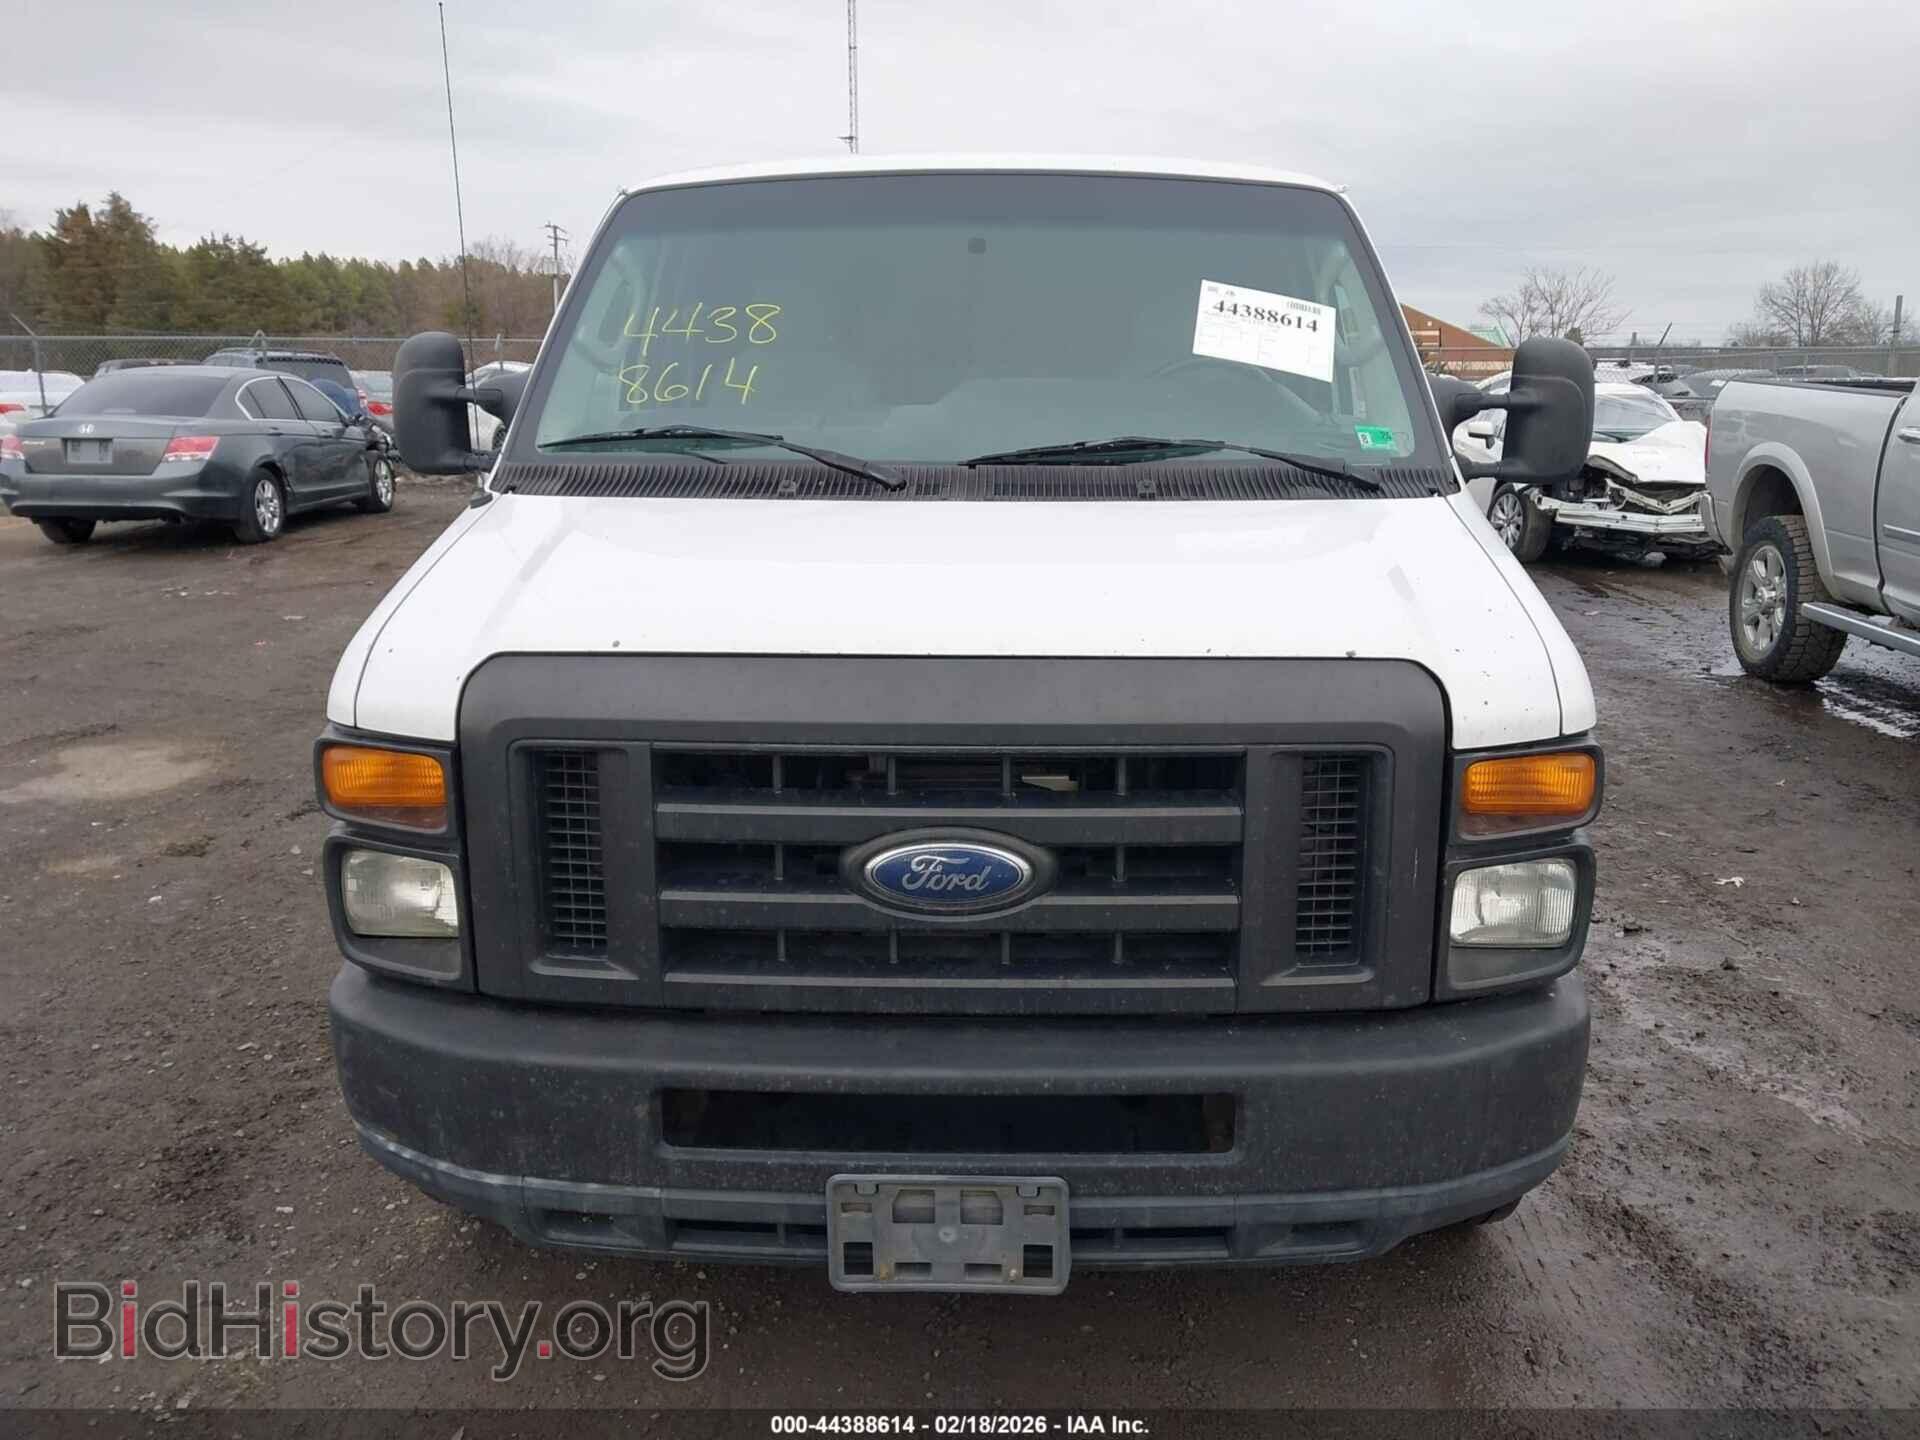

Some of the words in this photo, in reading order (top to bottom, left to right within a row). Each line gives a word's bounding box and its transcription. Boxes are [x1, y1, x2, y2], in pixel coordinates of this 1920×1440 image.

[624, 302, 781, 356] 4438
[1213, 300, 1318, 332] 44388614
[618, 357, 761, 405] 8614
[902, 855, 992, 890] Ford
